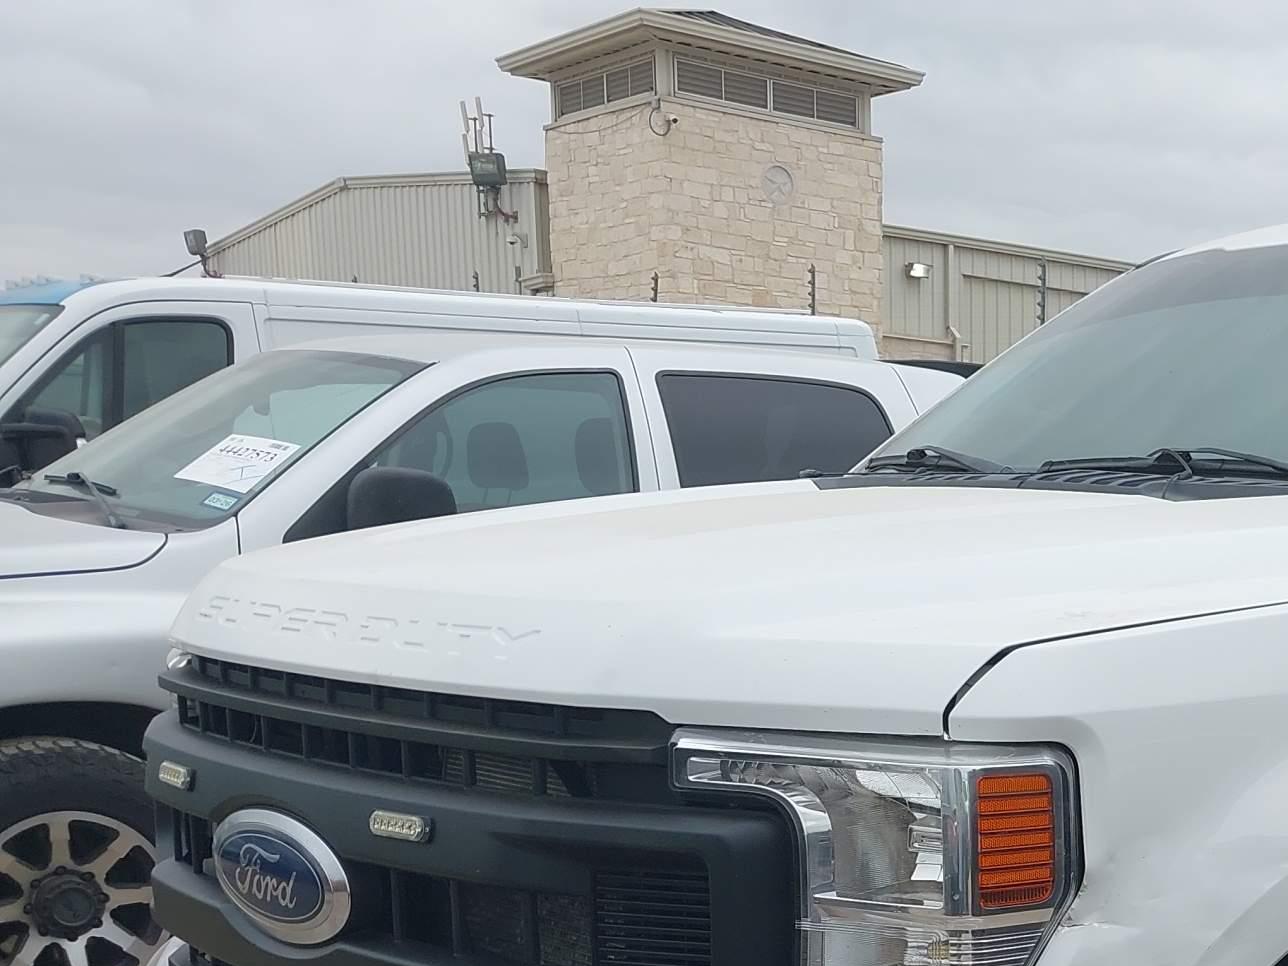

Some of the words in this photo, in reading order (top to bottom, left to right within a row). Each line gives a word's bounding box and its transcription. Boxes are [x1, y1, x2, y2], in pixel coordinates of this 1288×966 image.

[197, 595, 349, 639] SUPER
[358, 614, 543, 661] DUTY
[235, 843, 297, 909] Ford
